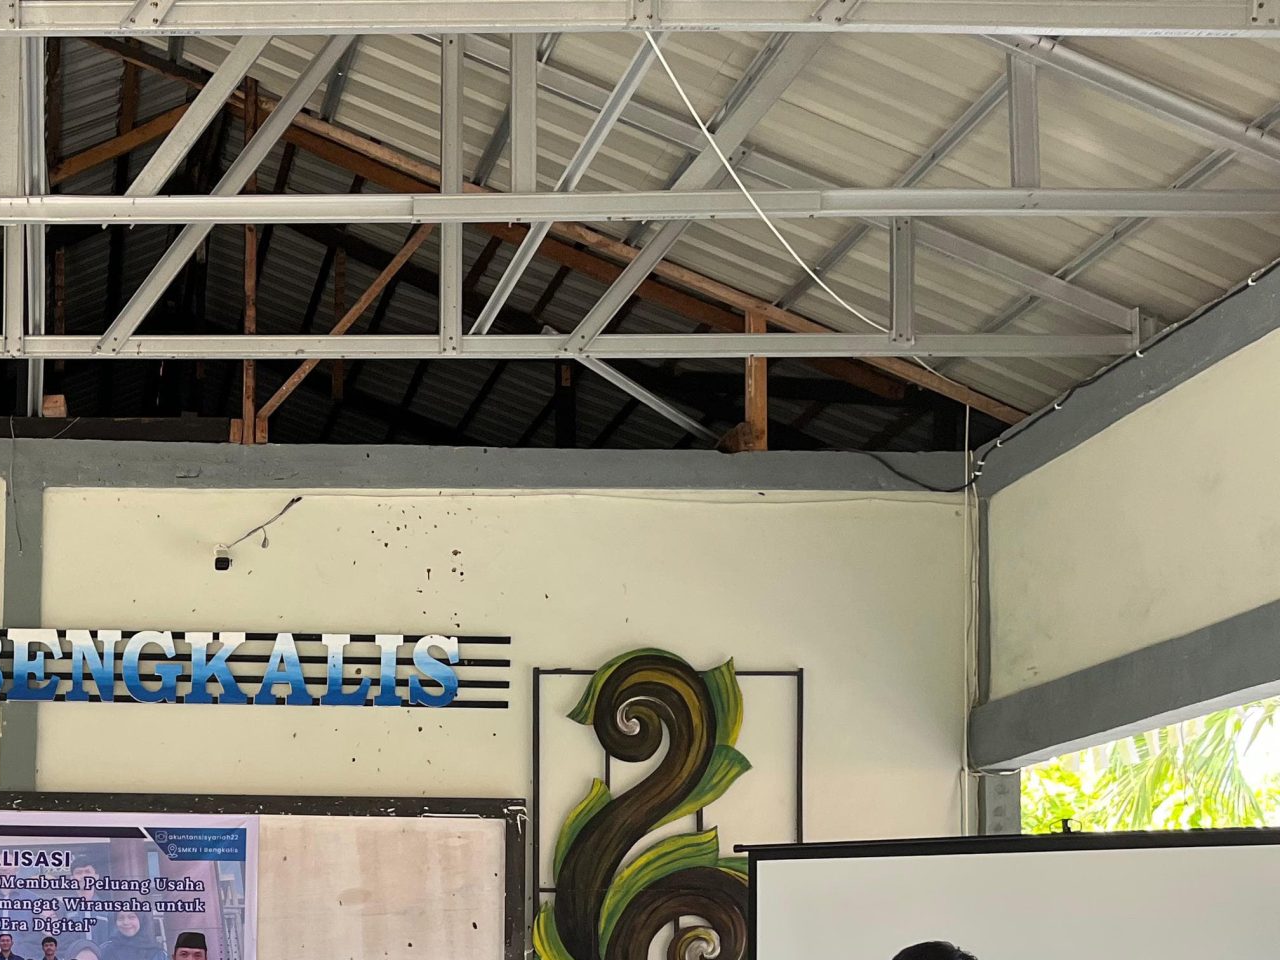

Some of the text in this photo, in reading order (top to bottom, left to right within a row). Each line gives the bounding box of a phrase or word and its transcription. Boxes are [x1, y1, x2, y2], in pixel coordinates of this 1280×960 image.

[0, 875, 79, 890] Membuka
[84, 877, 150, 894] Peluang
[155, 877, 205, 892] Usaha
[63, 897, 151, 912] Wirausaha
[155, 899, 206, 913] untuk
[0, 917, 28, 932] Era
